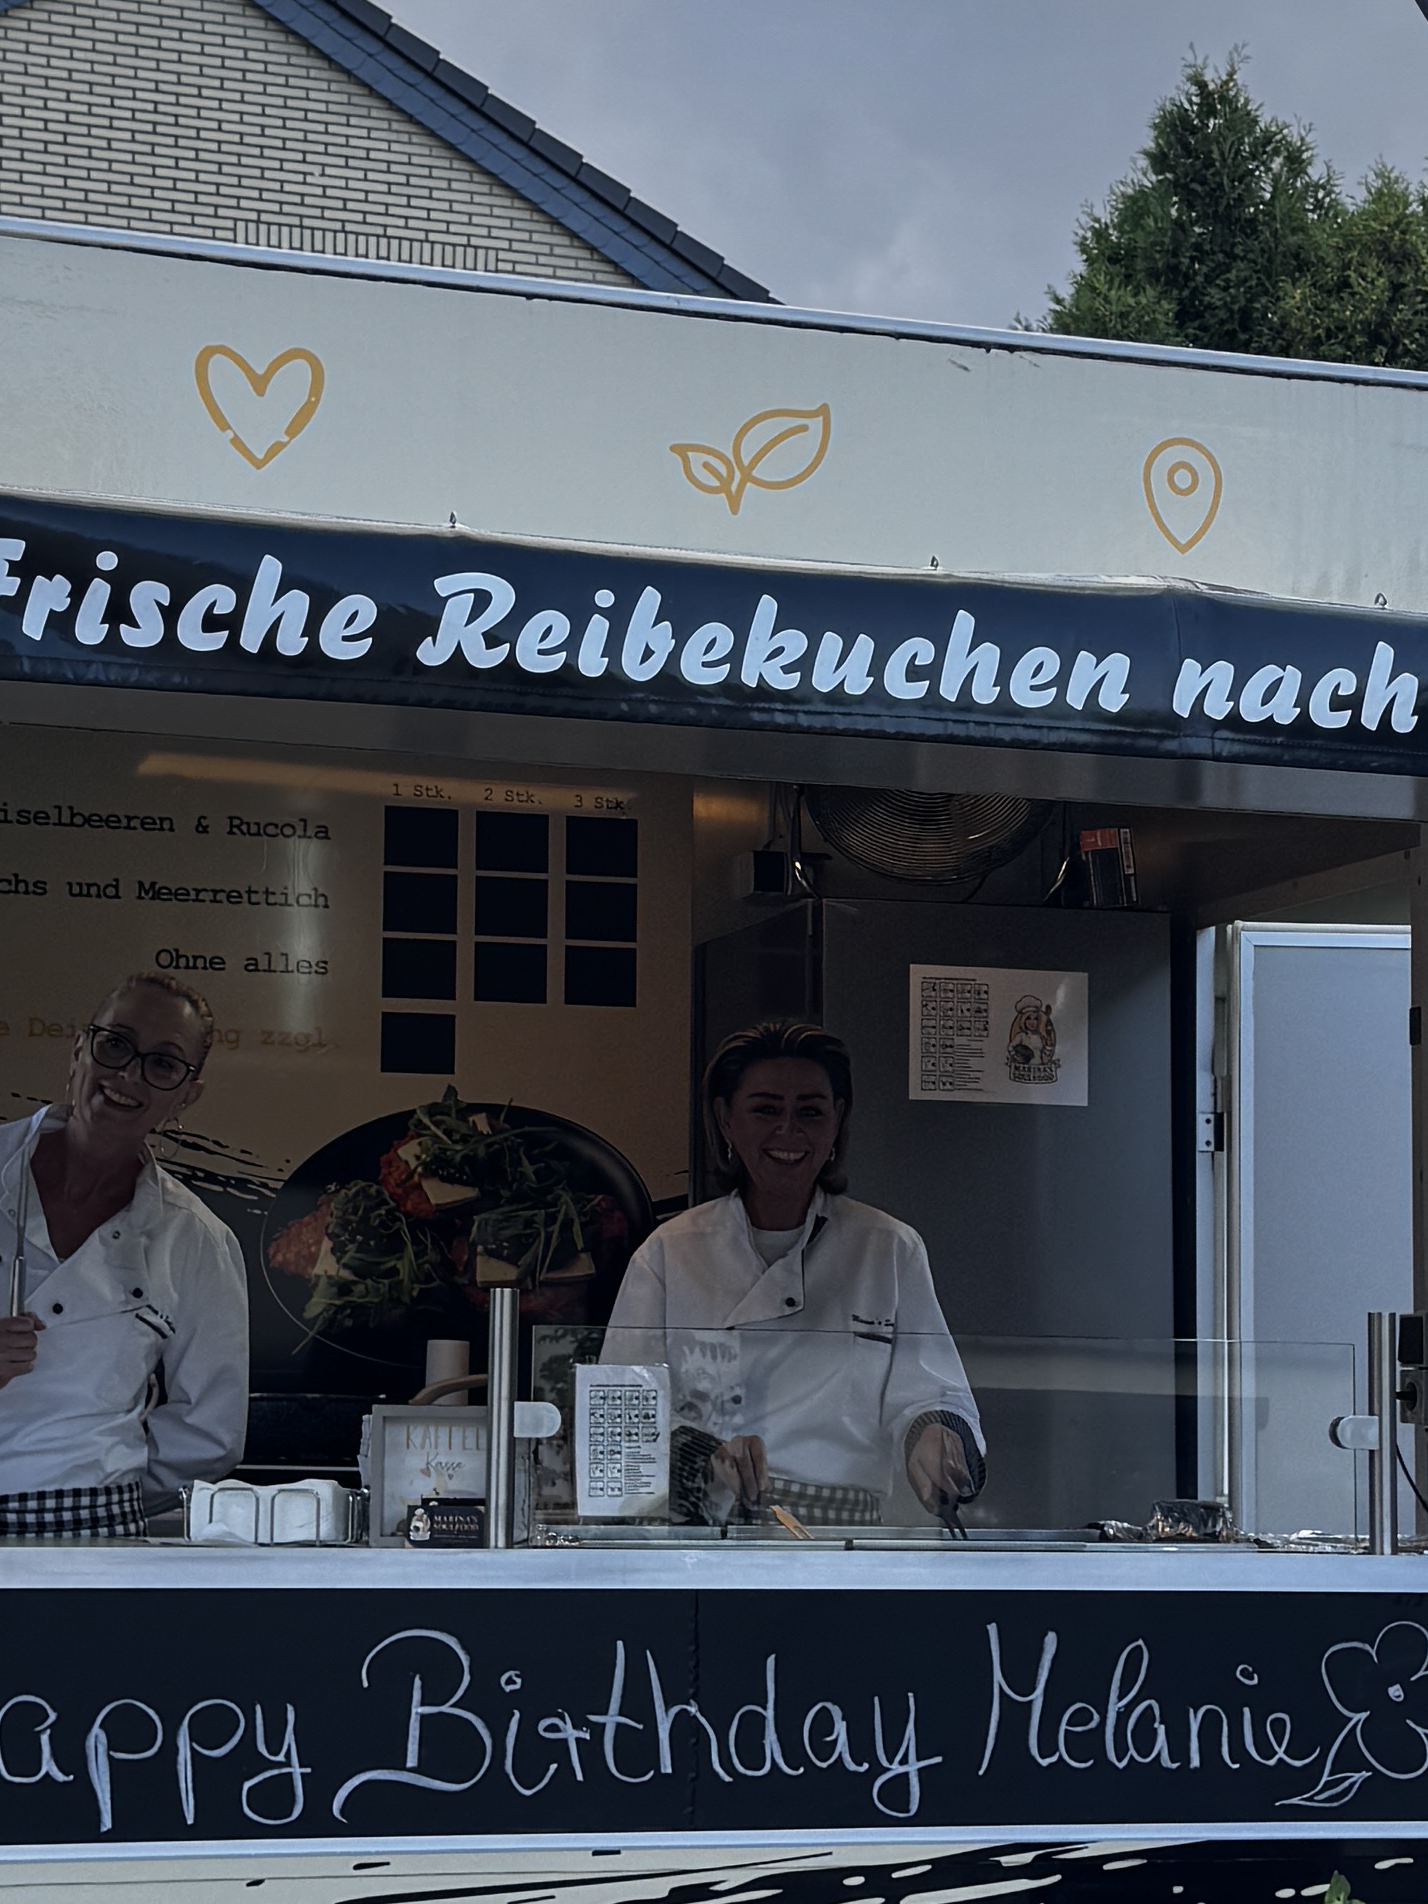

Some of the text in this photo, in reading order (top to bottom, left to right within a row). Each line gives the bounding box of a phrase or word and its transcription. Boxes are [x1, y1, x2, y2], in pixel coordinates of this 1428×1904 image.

[416, 571, 1131, 713] Reibekuchen
[1172, 641, 1420, 733] nach
[392, 783, 452, 800] 1 Stk.
[484, 788, 543, 805] 2 Stk.
[574, 794, 583, 809] 3
[195, 815, 210, 835] &
[227, 815, 332, 841] Rucola
[67, 878, 121, 901] und
[136, 879, 330, 910] Meerrettich
[155, 948, 329, 976] Ohne alles
[333, 1627, 941, 1824] Birthday
[977, 1622, 1321, 1776] Melanie
